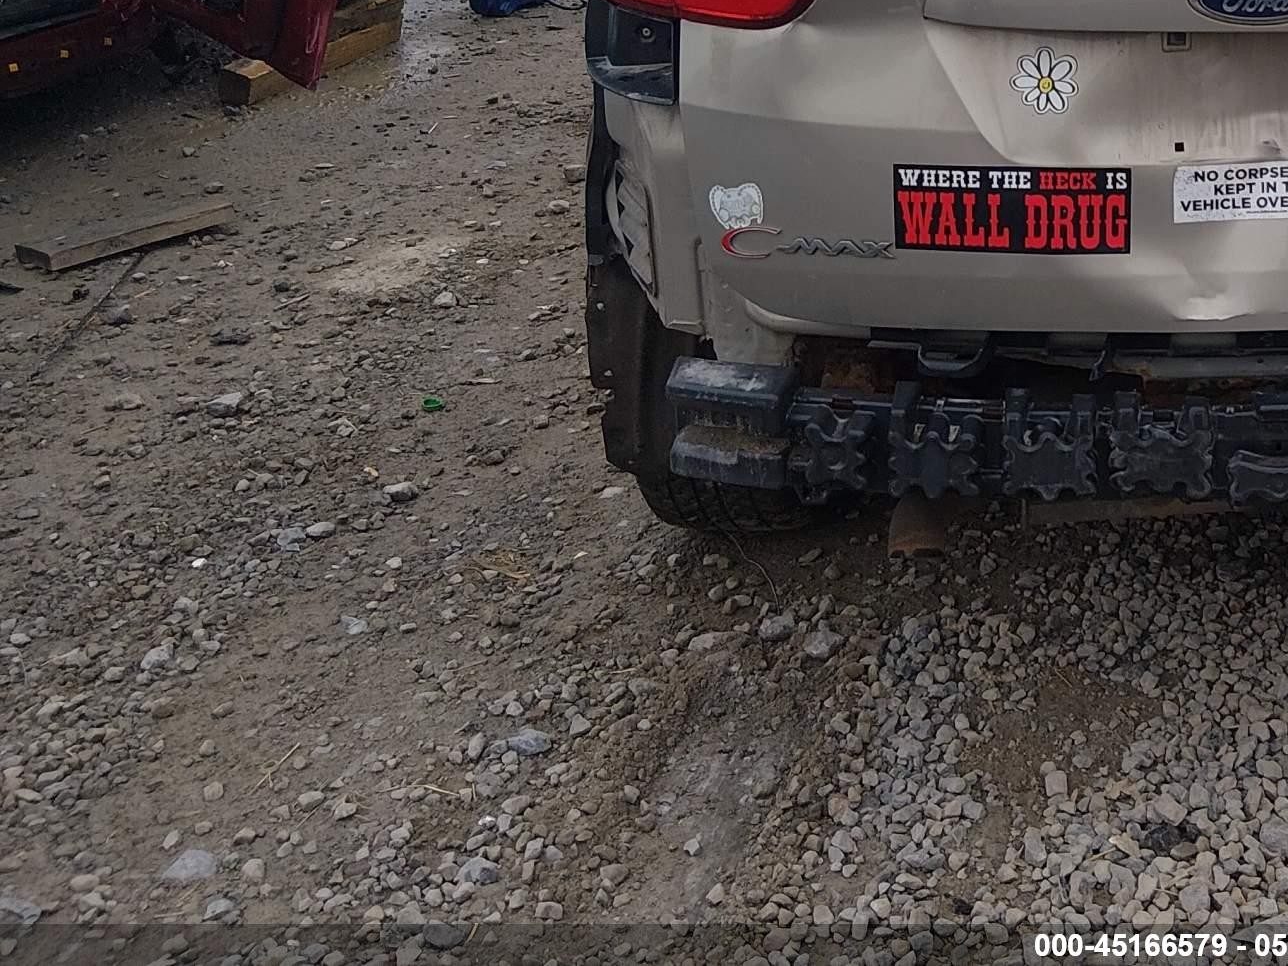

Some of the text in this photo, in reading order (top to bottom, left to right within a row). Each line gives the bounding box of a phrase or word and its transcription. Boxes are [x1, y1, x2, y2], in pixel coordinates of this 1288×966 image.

[898, 169, 1128, 190] WHERE THE HECK IS
[1194, 170, 1219, 183] NO
[1213, 182, 1257, 196] KEPT
[1261, 181, 1277, 194] IN
[1180, 197, 1251, 212] VEHICLE
[897, 190, 1128, 250] WALL DRUG
